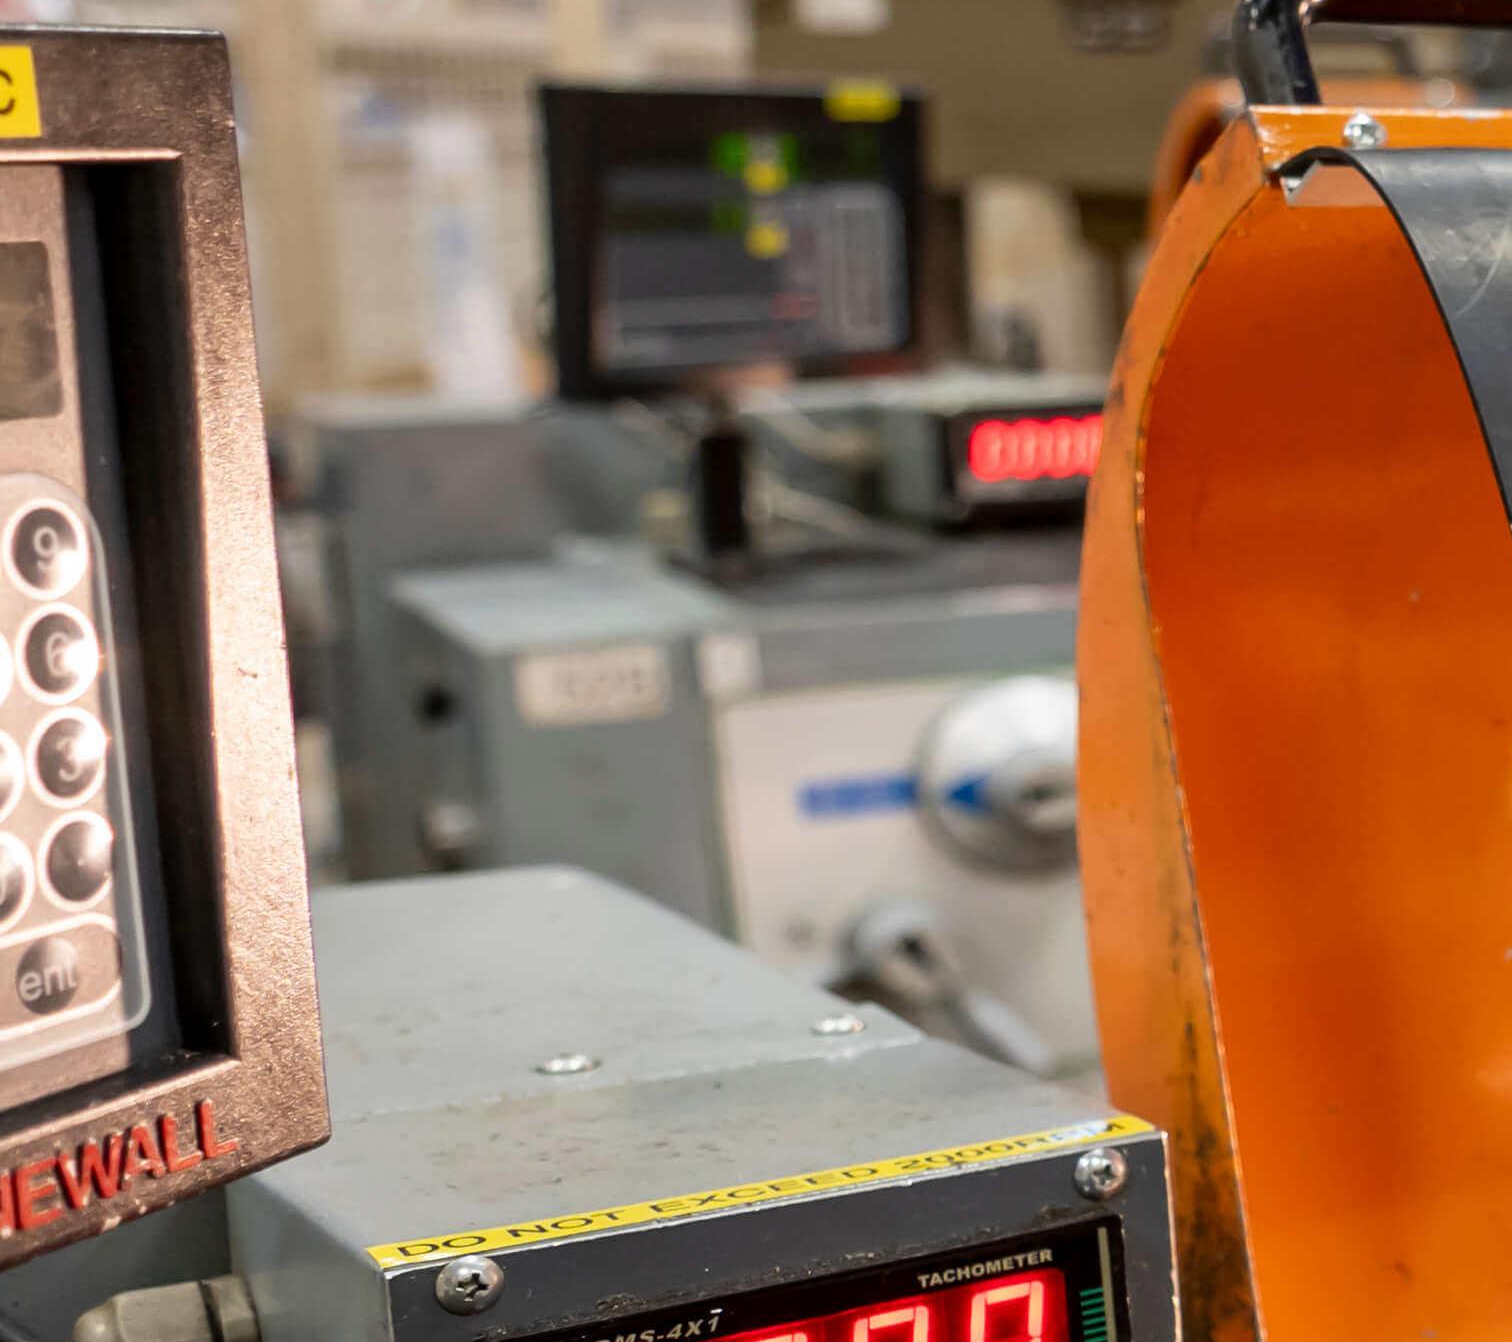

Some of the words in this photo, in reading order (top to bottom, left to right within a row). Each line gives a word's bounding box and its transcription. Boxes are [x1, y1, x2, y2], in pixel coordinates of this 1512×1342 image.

[34, 525, 60, 574] 9
[396, 1235, 487, 1257] DO
[507, 1209, 626, 1238] NOT
[649, 1167, 878, 1214] EXCEED
[917, 1248, 1053, 1289] TACHOMETER
